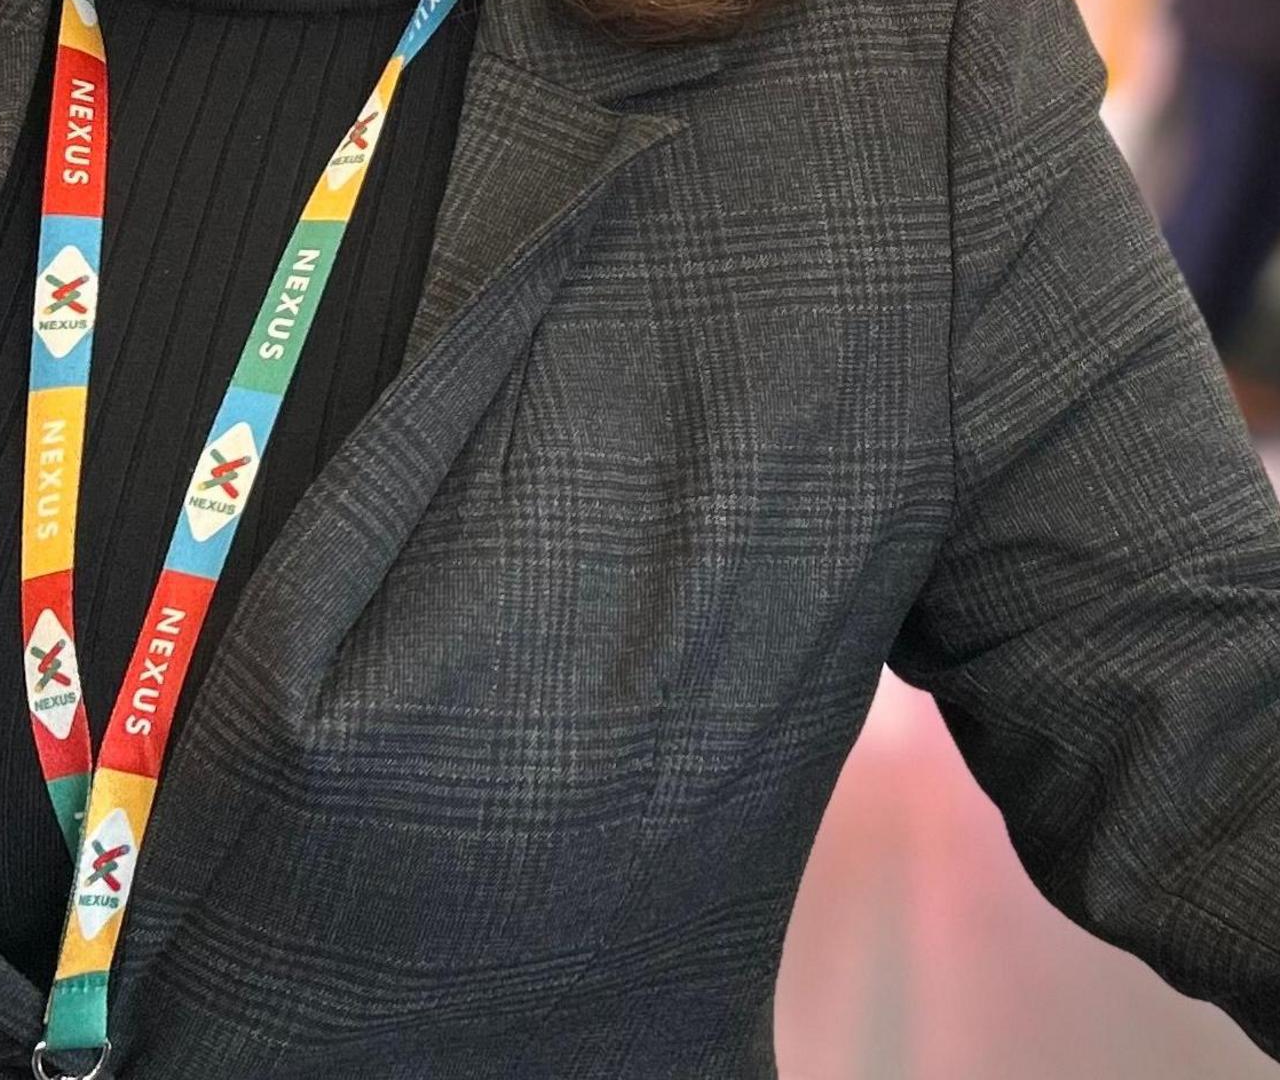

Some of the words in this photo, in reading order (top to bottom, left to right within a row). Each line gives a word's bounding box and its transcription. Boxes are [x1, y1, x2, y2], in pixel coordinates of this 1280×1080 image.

[62, 79, 95, 185] NEXUS
[38, 320, 88, 331] NEXUS
[259, 249, 320, 360] NEXUS
[39, 421, 65, 539] NEXUS
[190, 496, 236, 515] NEXUS
[35, 692, 75, 711] NEXUS
[126, 607, 186, 735] NEXUS
[79, 895, 119, 908] NEXUS
